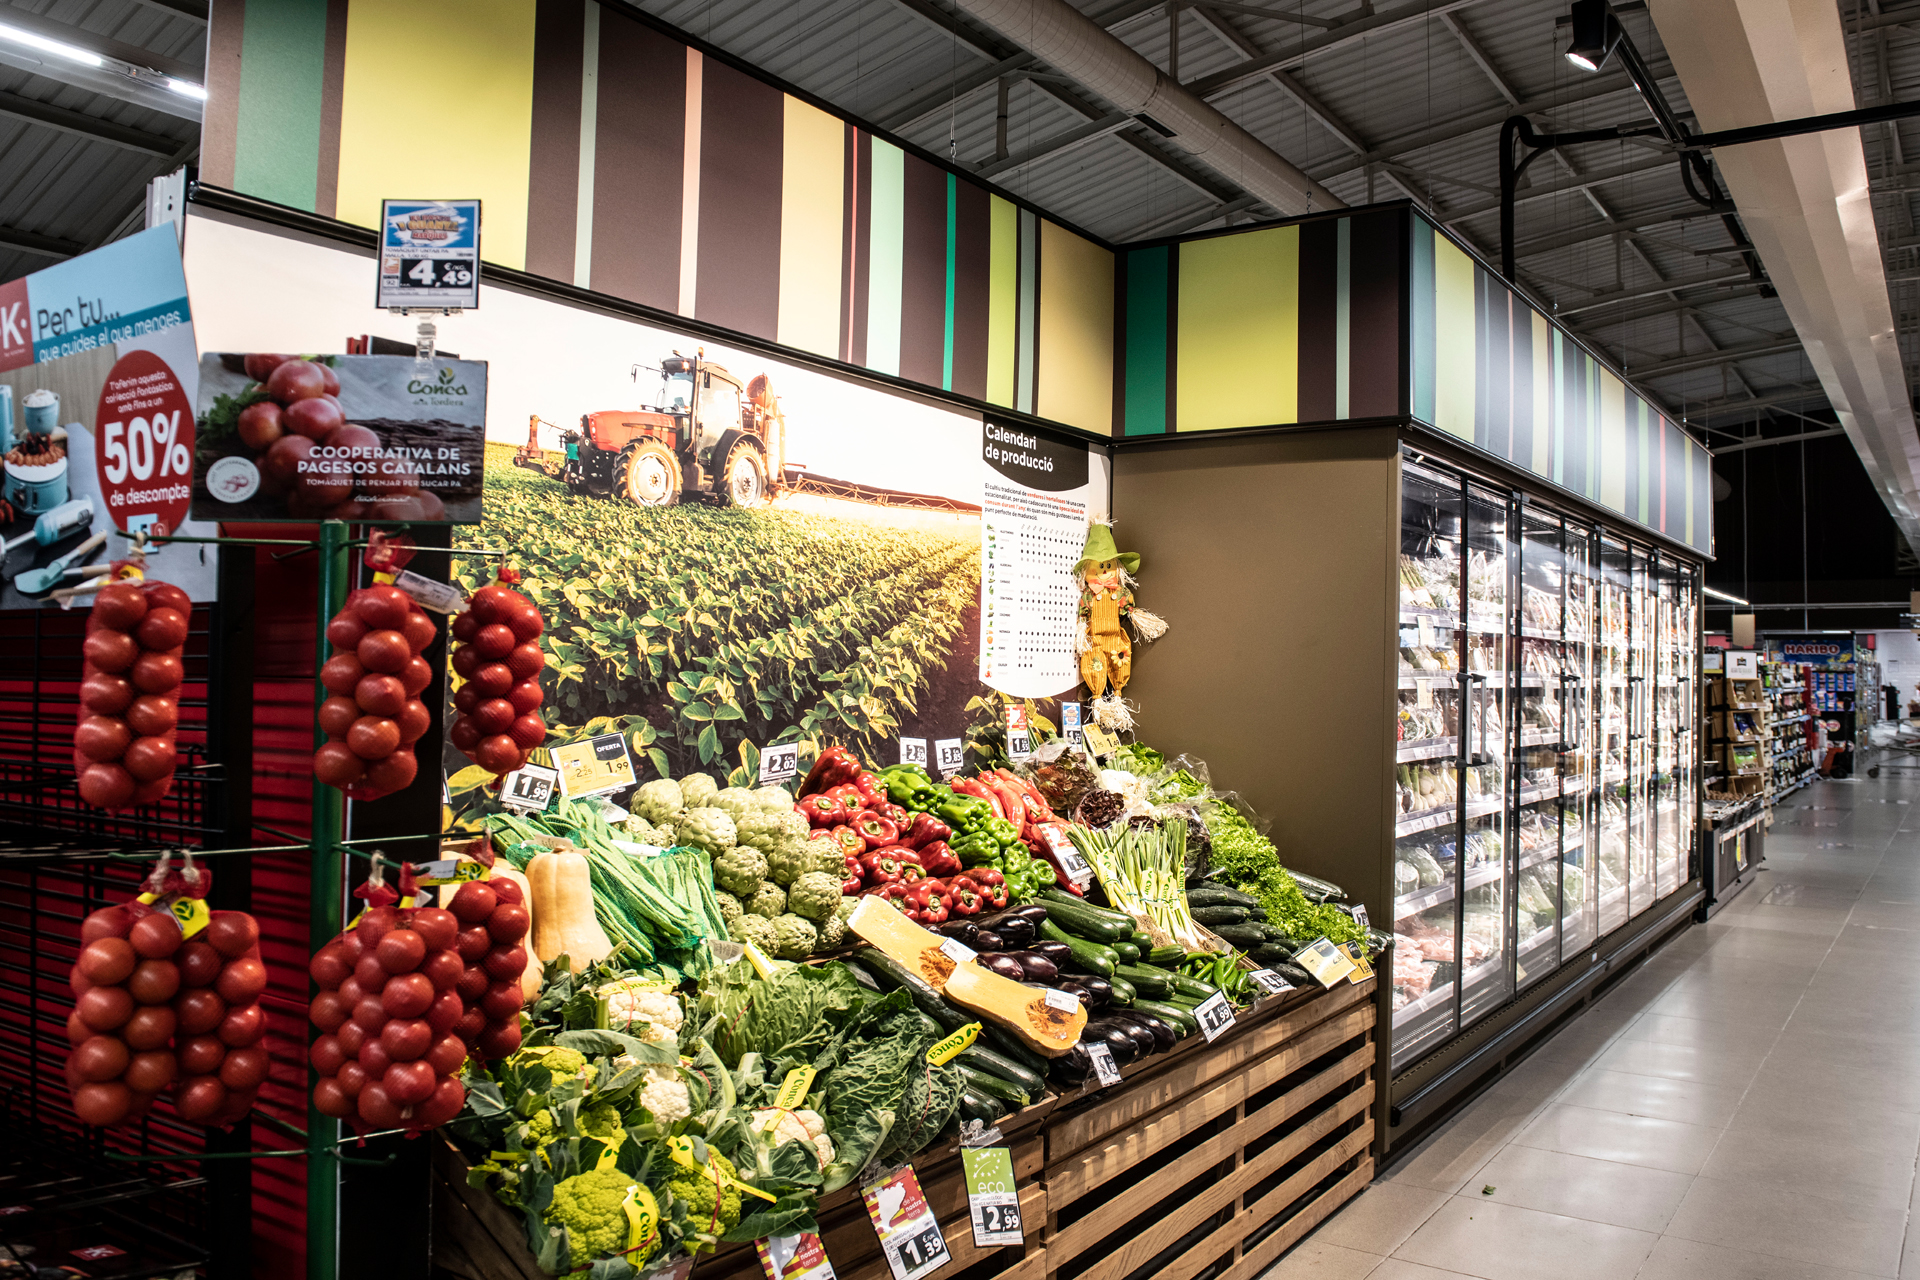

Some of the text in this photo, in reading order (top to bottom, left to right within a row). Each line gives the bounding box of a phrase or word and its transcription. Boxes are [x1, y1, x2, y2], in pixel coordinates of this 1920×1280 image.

[408, 259, 472, 288] 4,49
[37, 295, 120, 340] Per tu...
[39, 310, 182, 366] que cuides el que menges
[138, 371, 167, 385] aquesta
[407, 380, 468, 396] Conca
[118, 397, 163, 413] amb fins a un
[430, 397, 464, 406] Tordera
[985, 423, 1037, 450] Calendari
[104, 410, 190, 485] 50%
[308, 446, 461, 461] COOPERATIVA DE
[985, 443, 1054, 472] de producció
[297, 461, 471, 476] PAGESOS CATALANS
[306, 476, 353, 487] TOMÀQUET
[355, 479, 367, 487] DE
[368, 479, 401, 487] PENJAR
[450, 480, 462, 488] PA
[110, 482, 190, 507] de descompte
[1001, 487, 1021, 496] tradicional
[1027, 492, 1044, 500] verdures
[1785, 643, 1840, 655] HARIBO
[596, 743, 621, 753] OFERTA
[606, 761, 629, 773] 1,99
[771, 755, 795, 772] 2,02
[521, 776, 548, 800] 1,99
[1205, 1009, 1230, 1027] 1,99
[928, 1035, 965, 1060] Conca
[783, 1079, 805, 1108] Conca
[978, 1181, 1006, 1194] eco
[902, 1198, 910, 1206] de
[905, 1200, 923, 1212] nostra
[907, 1208, 921, 1219] terra
[986, 1206, 1020, 1232] 2,99
[797, 1245, 806, 1253] de
[800, 1247, 820, 1260] nostra
[905, 1237, 942, 1265] 1,39
[802, 1256, 817, 1267] terra
